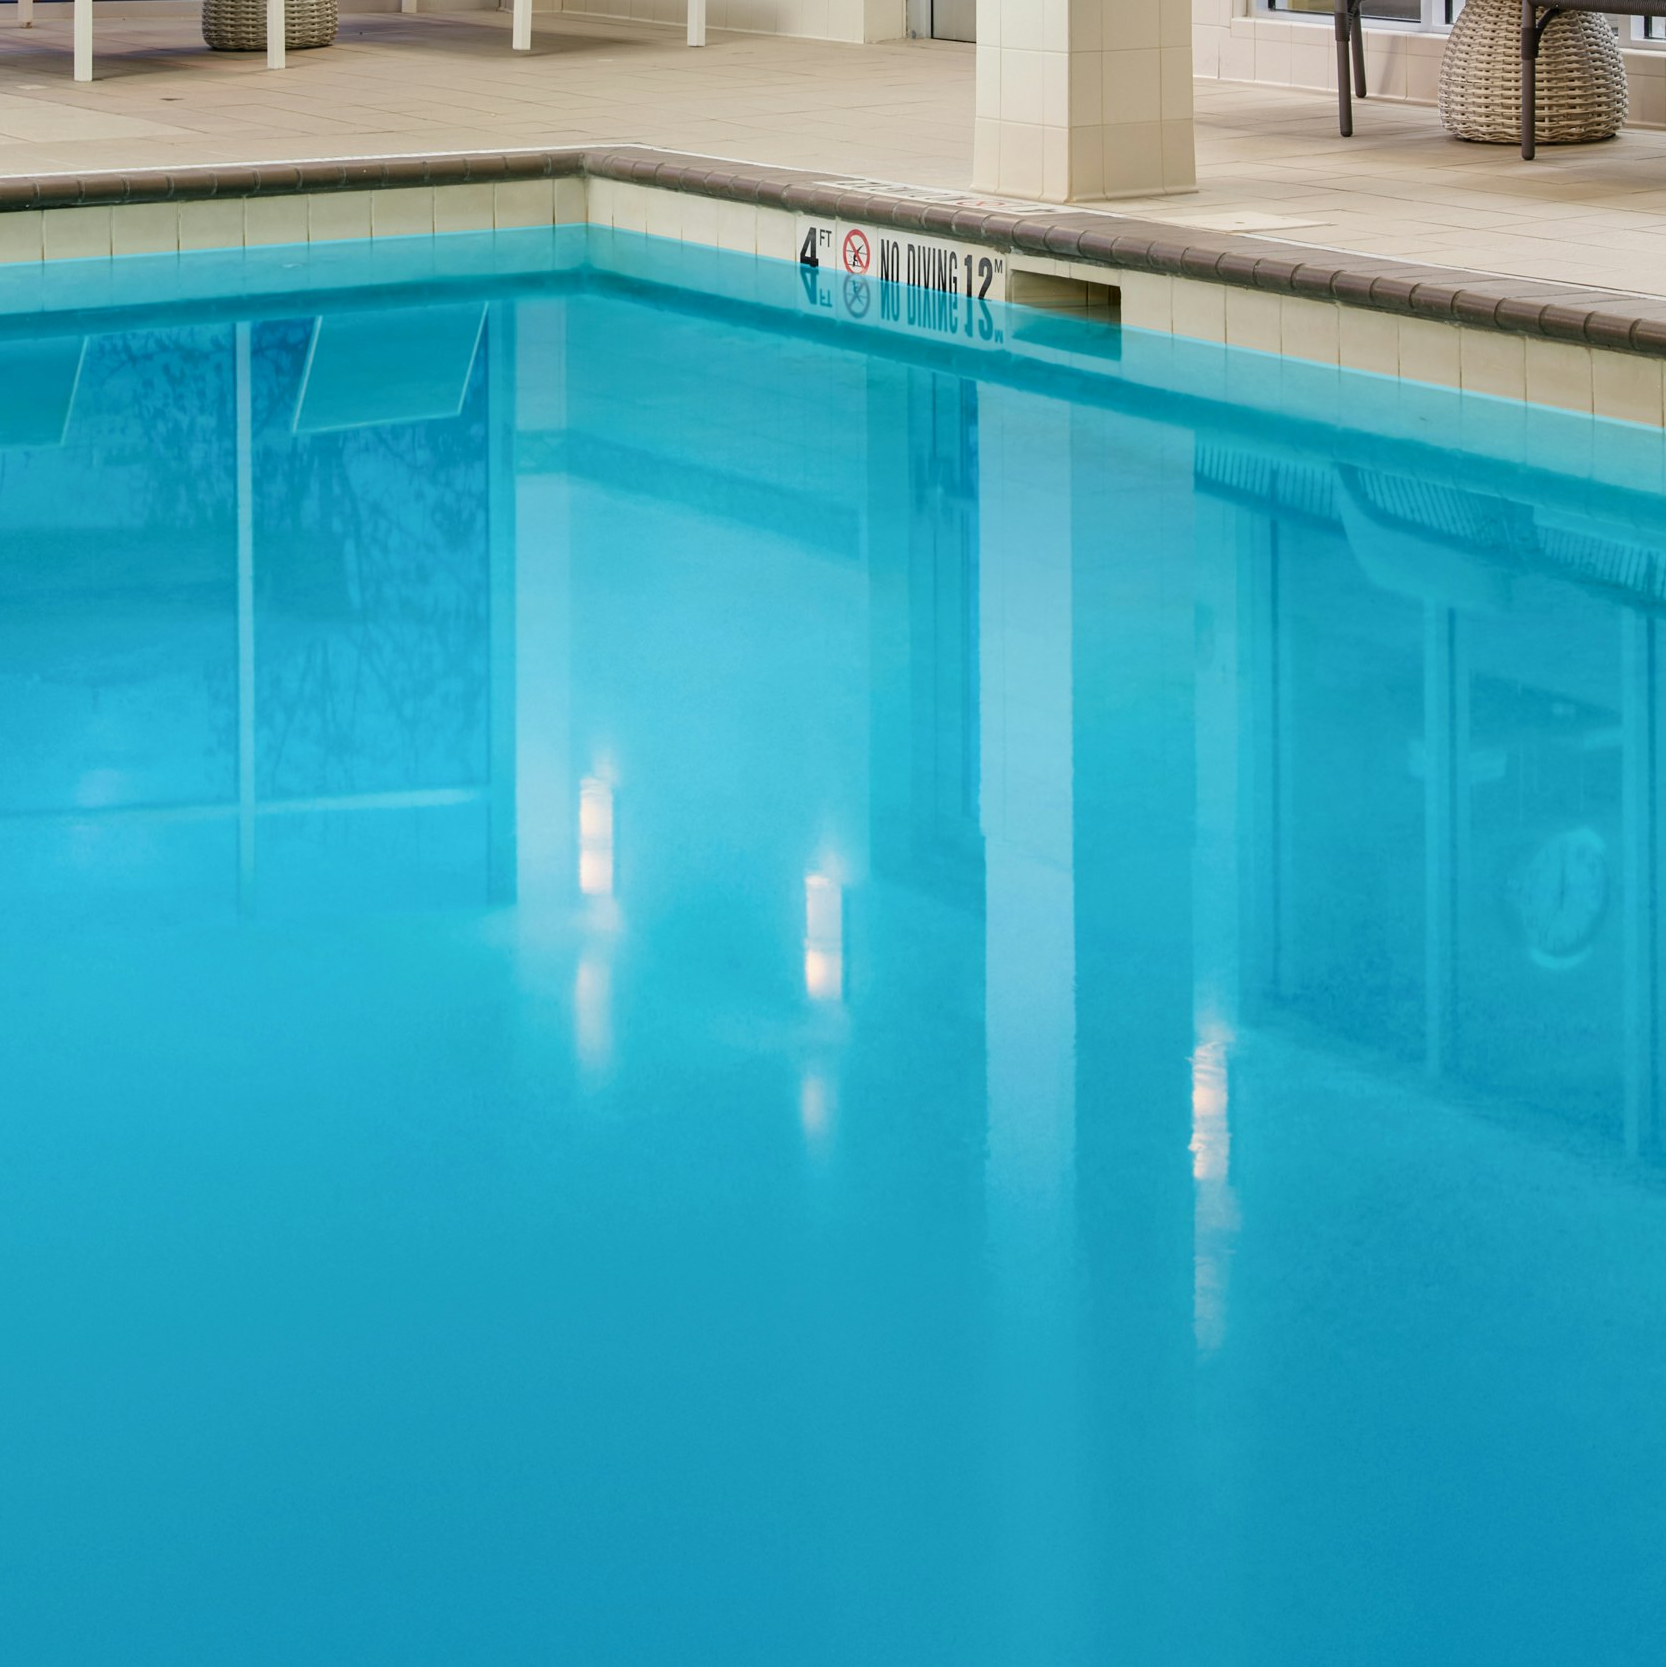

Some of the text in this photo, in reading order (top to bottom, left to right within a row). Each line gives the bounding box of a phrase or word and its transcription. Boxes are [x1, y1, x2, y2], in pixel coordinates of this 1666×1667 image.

[800, 227, 1003, 302] 4 FT NO DIVING 12 M
